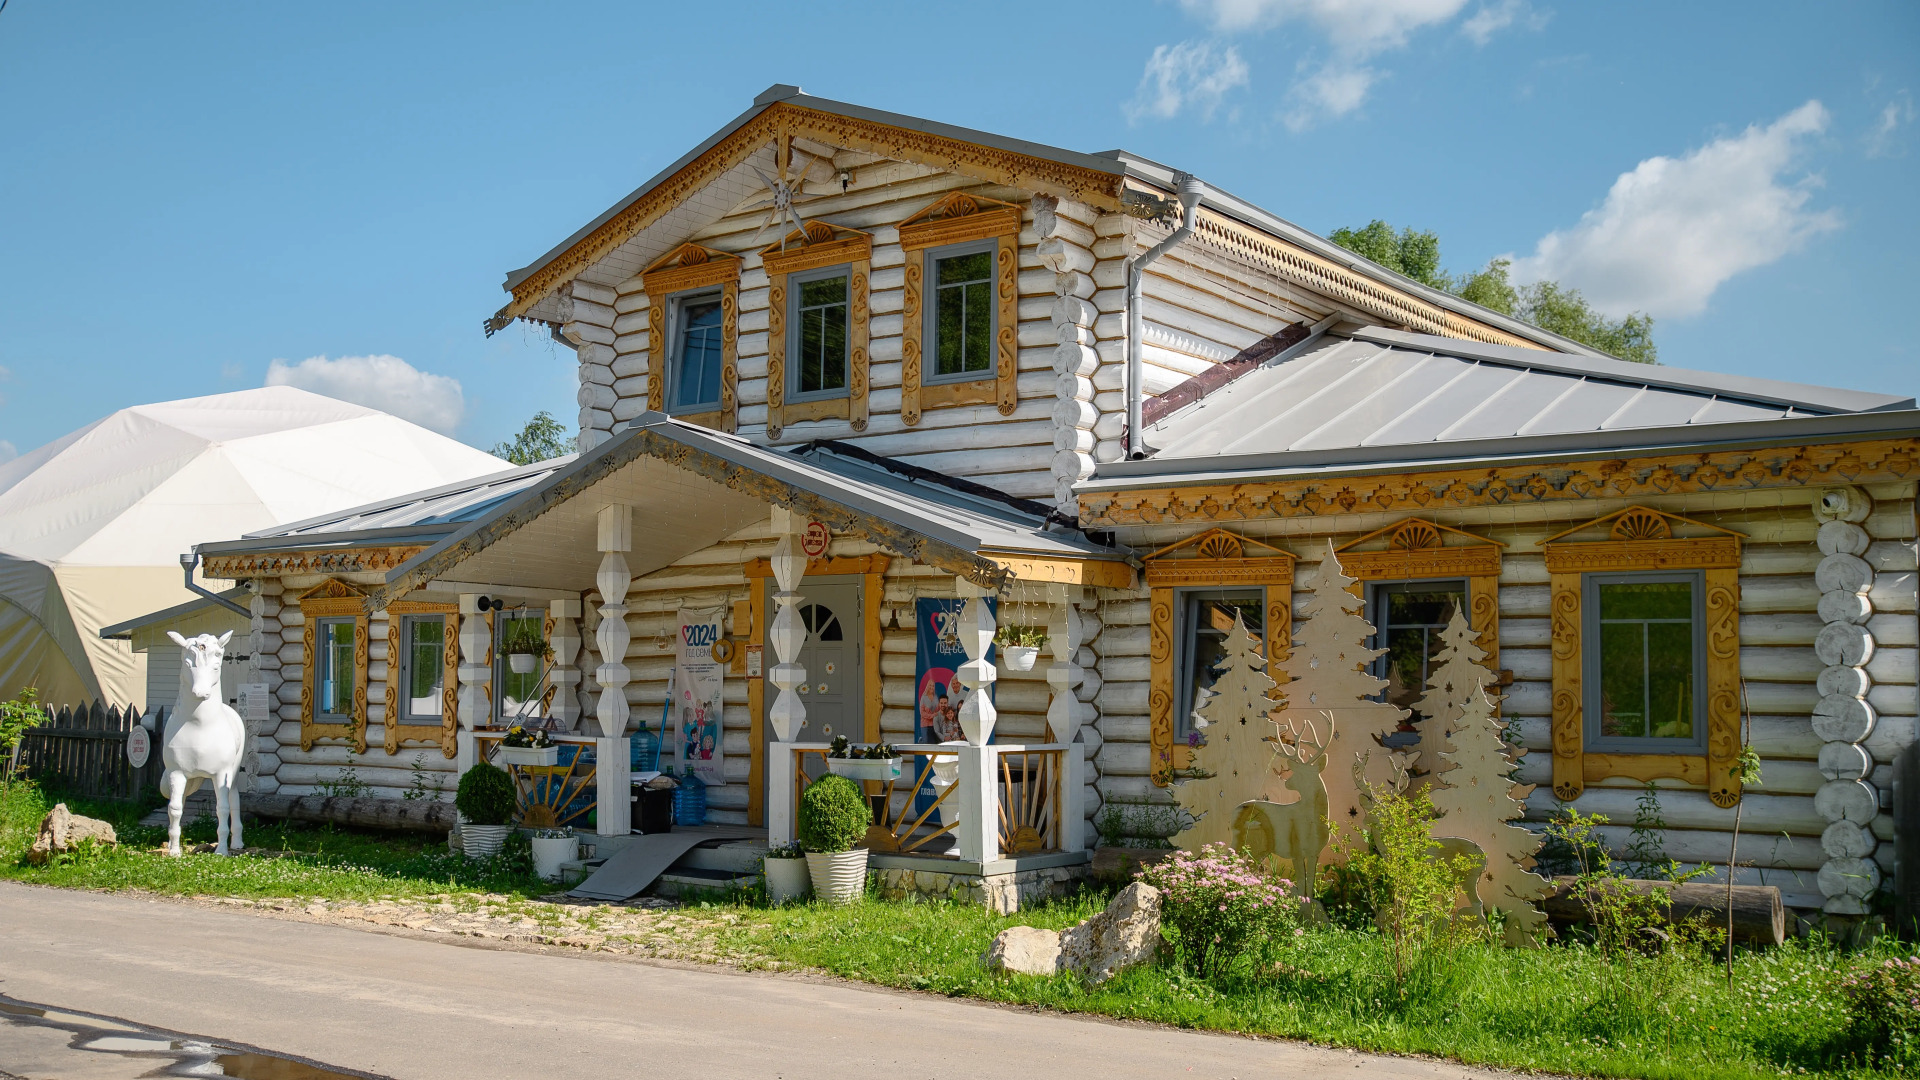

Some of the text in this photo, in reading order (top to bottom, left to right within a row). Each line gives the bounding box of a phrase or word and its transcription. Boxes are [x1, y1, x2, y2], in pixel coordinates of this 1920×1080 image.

[685, 624, 717, 646] 2024
[685, 648, 712, 659] ГОД СЕМЬ
